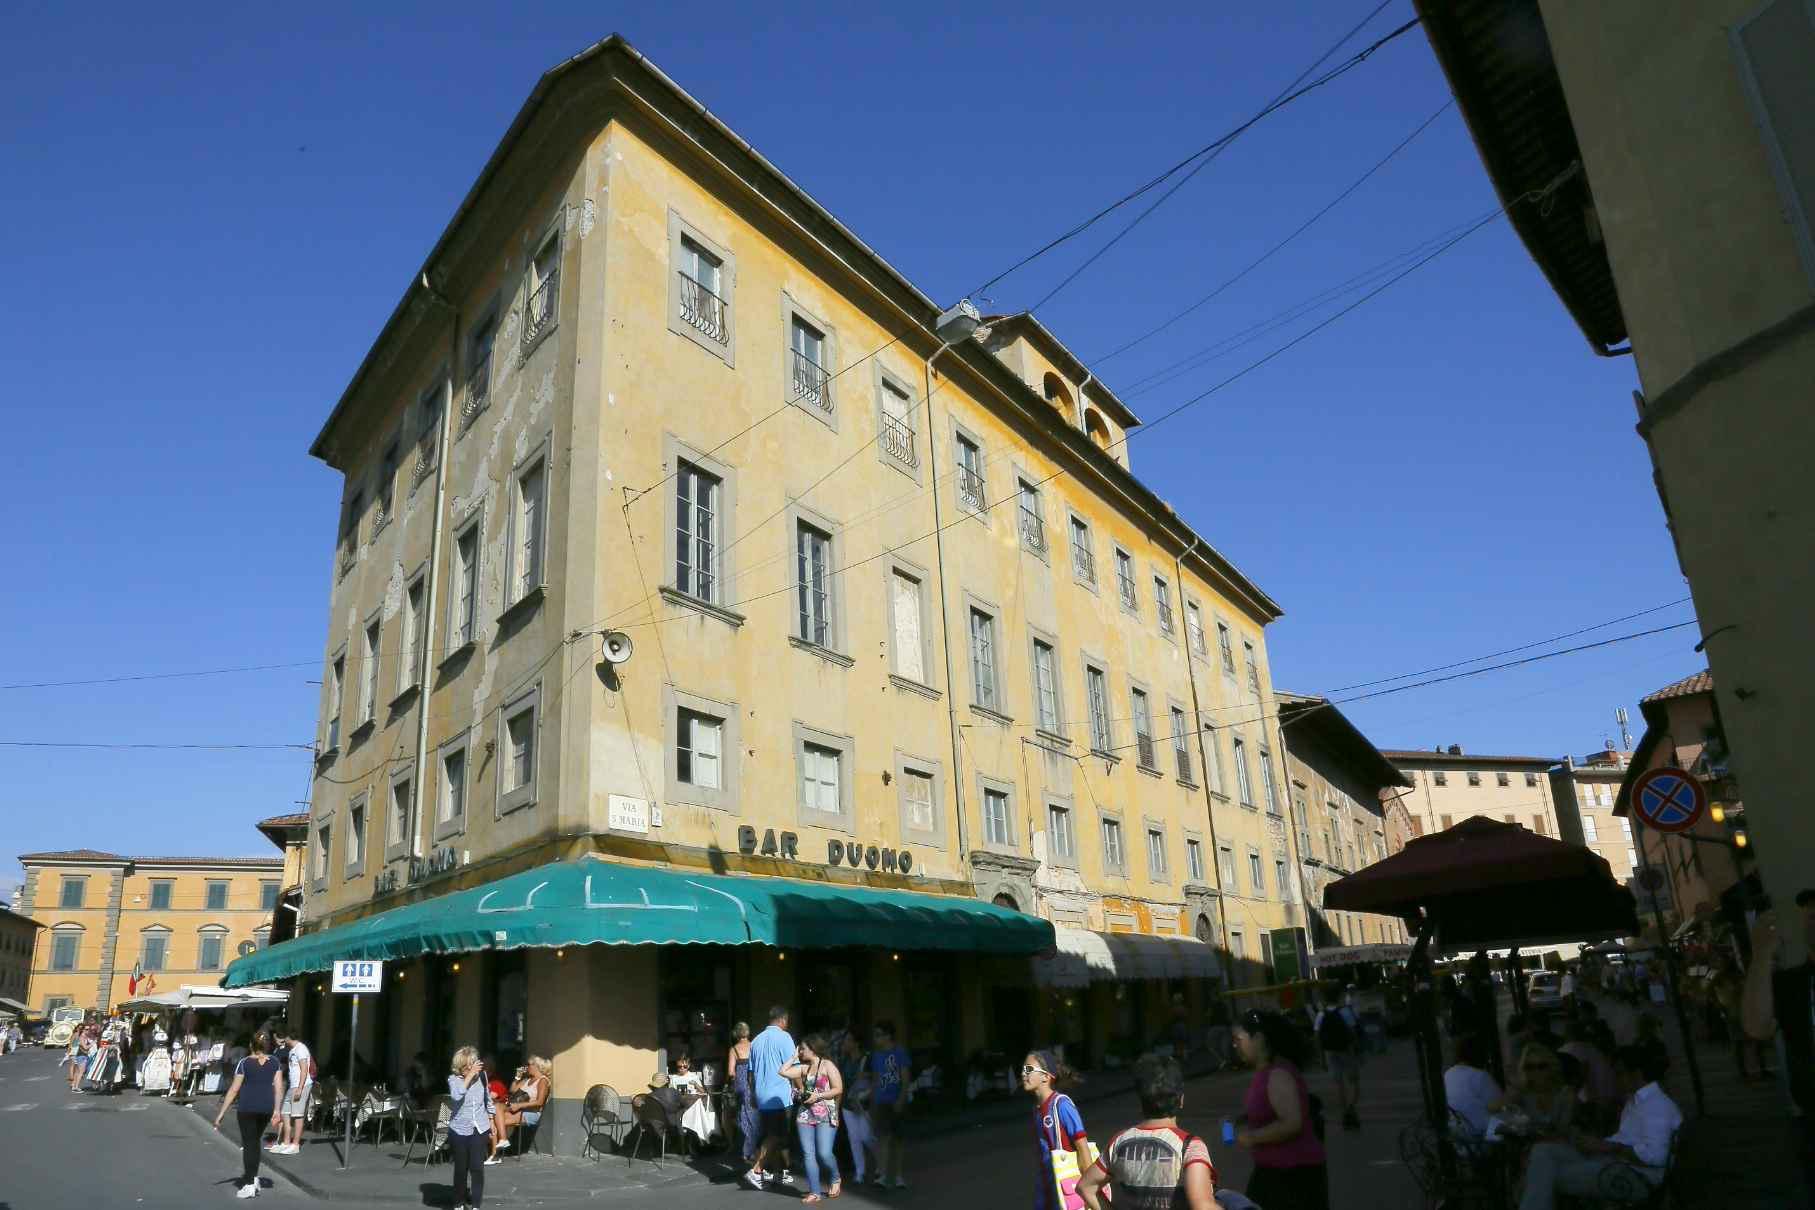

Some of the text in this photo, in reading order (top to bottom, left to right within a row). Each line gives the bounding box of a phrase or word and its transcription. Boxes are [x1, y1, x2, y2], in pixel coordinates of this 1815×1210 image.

[622, 802, 637, 813] VIA
[619, 815, 646, 828] MARIA
[738, 825, 913, 873] BAR DUOMO
